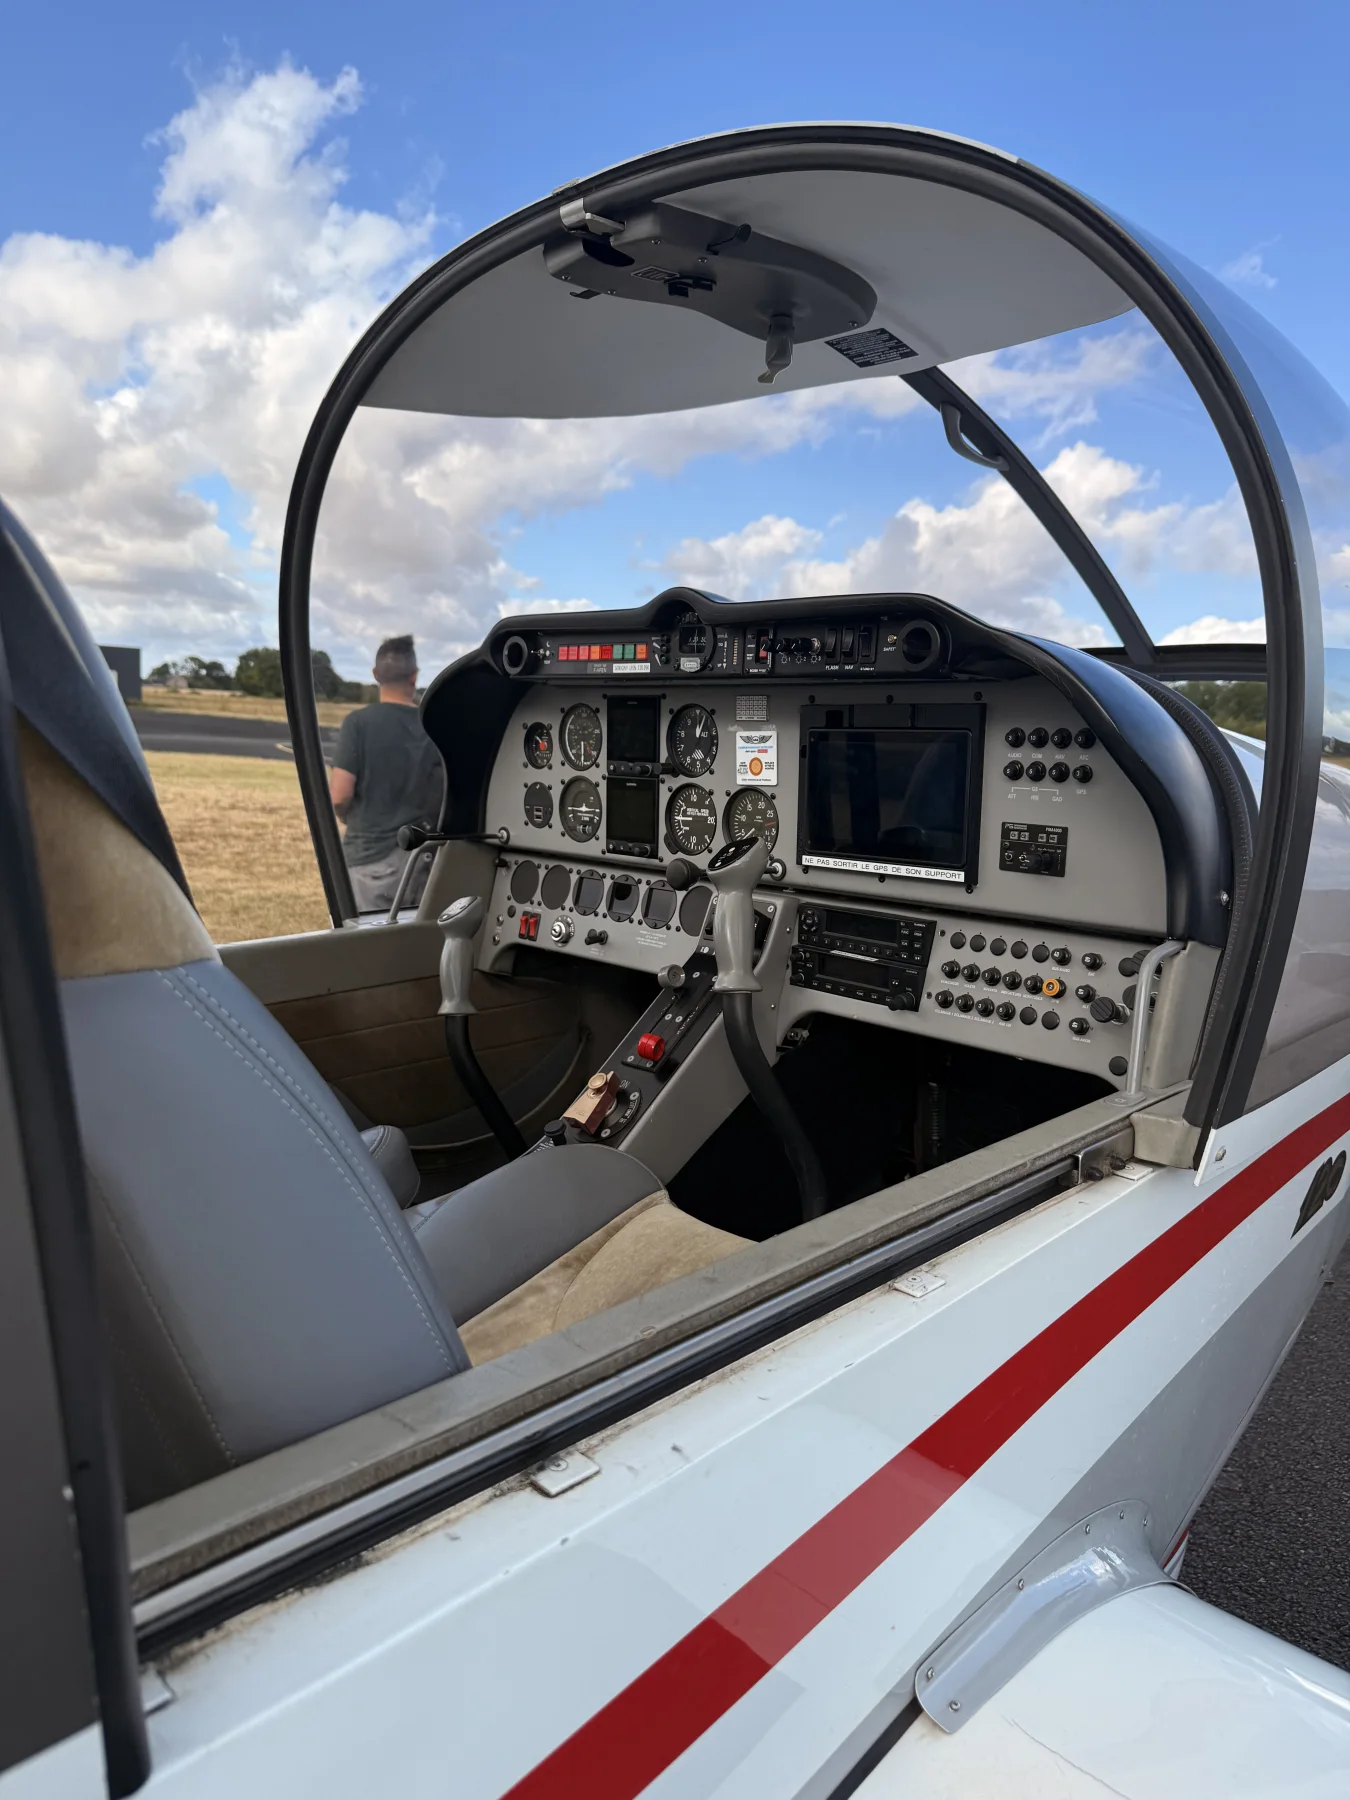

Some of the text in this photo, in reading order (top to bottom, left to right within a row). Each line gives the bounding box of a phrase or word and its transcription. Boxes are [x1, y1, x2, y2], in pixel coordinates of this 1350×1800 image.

[766, 810, 774, 818] 25
[816, 858, 830, 866] PAS
[832, 860, 858, 869] SORTIR
[873, 864, 889, 872] GPS
[924, 870, 962, 880] SUPPORT
